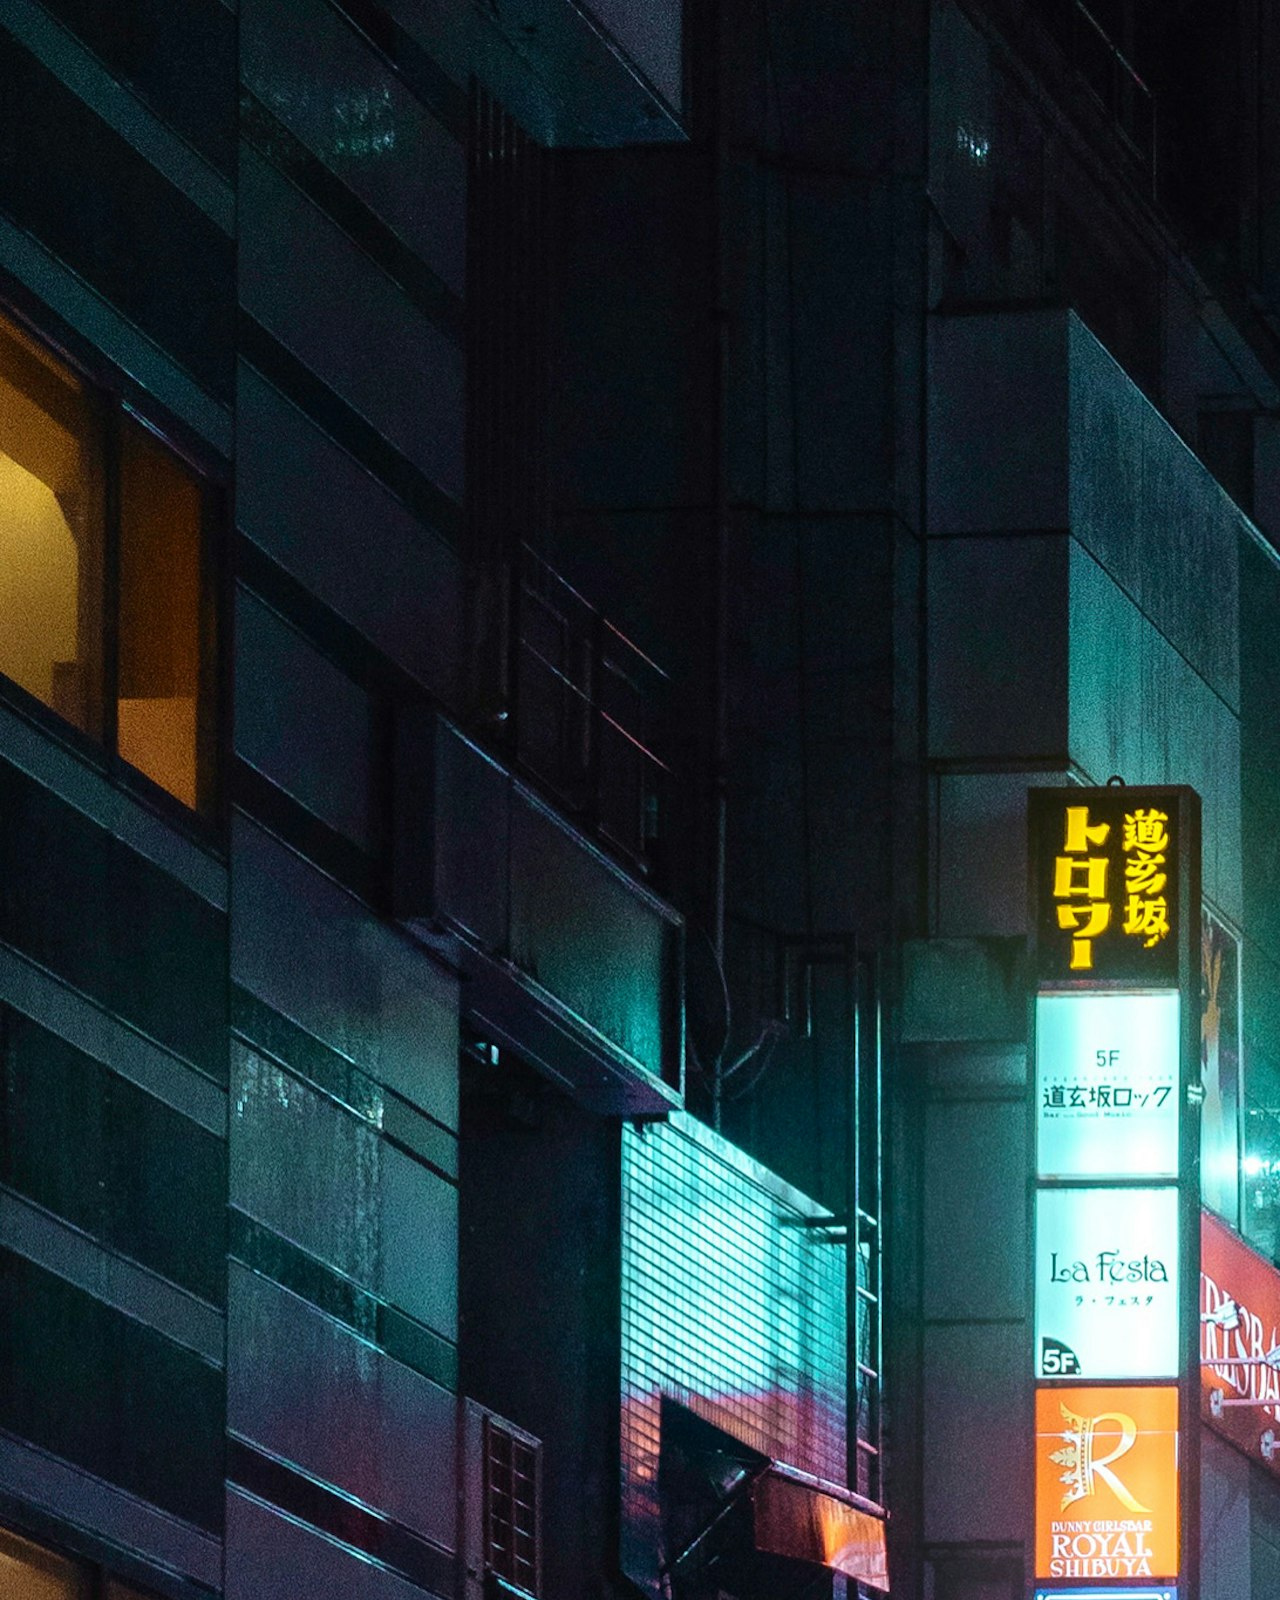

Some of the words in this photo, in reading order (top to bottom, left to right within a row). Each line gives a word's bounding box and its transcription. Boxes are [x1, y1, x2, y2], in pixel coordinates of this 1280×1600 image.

[1053, 805, 1110, 971] トロワー
[1122, 809, 1171, 947] 道玄坂
[1096, 1050, 1121, 1067] 5F
[1042, 1085, 1173, 1109] 道玄坂ロック
[1051, 1533, 1152, 1557] ROYAL
[1049, 1558, 1153, 1578] SHIBUYA
